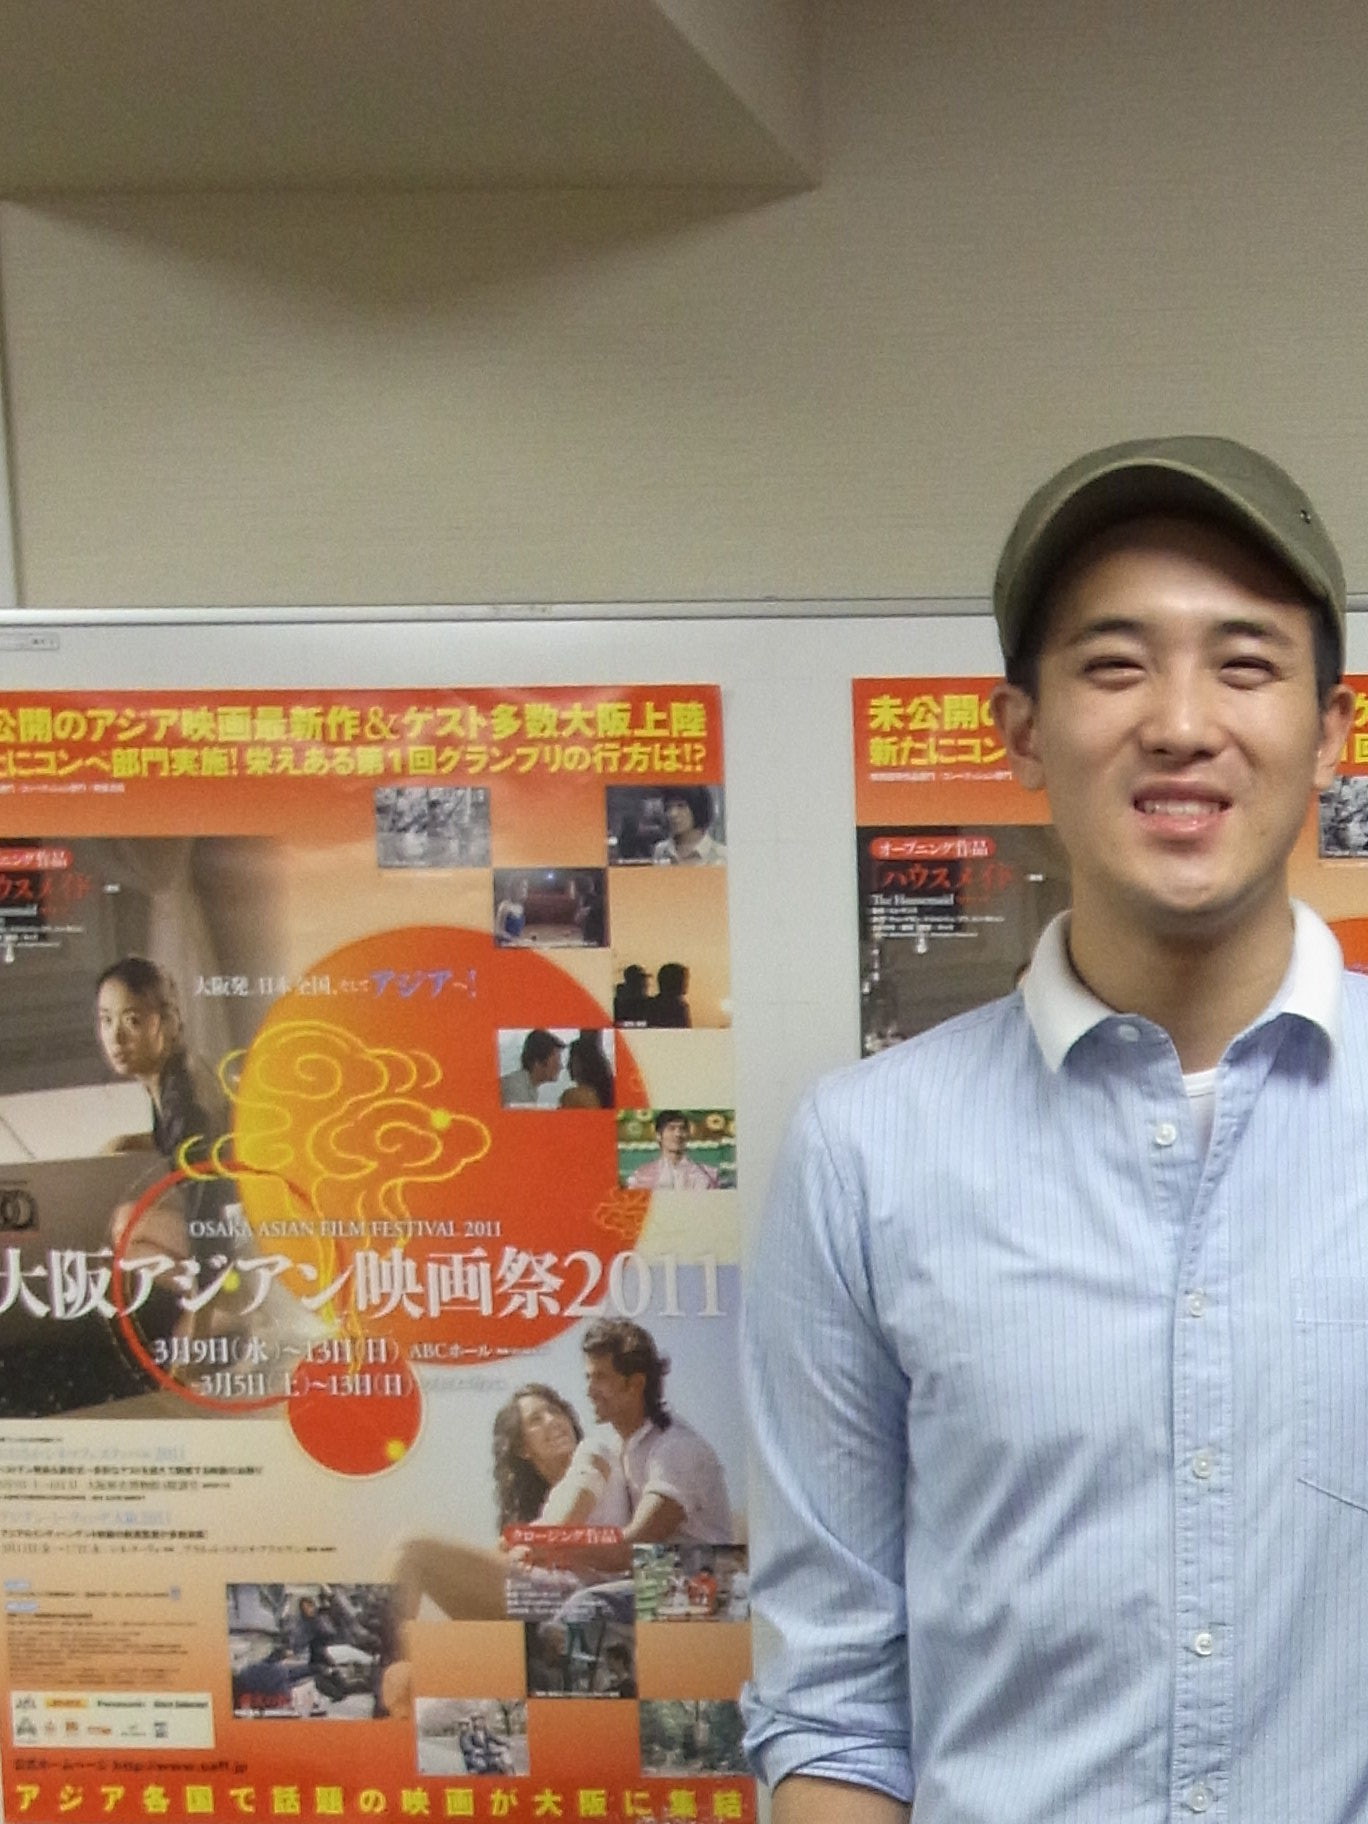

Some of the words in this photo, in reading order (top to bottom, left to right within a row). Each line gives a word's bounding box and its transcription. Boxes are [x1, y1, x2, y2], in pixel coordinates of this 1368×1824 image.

[189, 1221, 252, 1238] OSAKA
[259, 1221, 314, 1237] ASIAN
[320, 1221, 367, 1237] FILM
[371, 1221, 457, 1237] FESTIVAL
[463, 1221, 502, 1237] 2011
